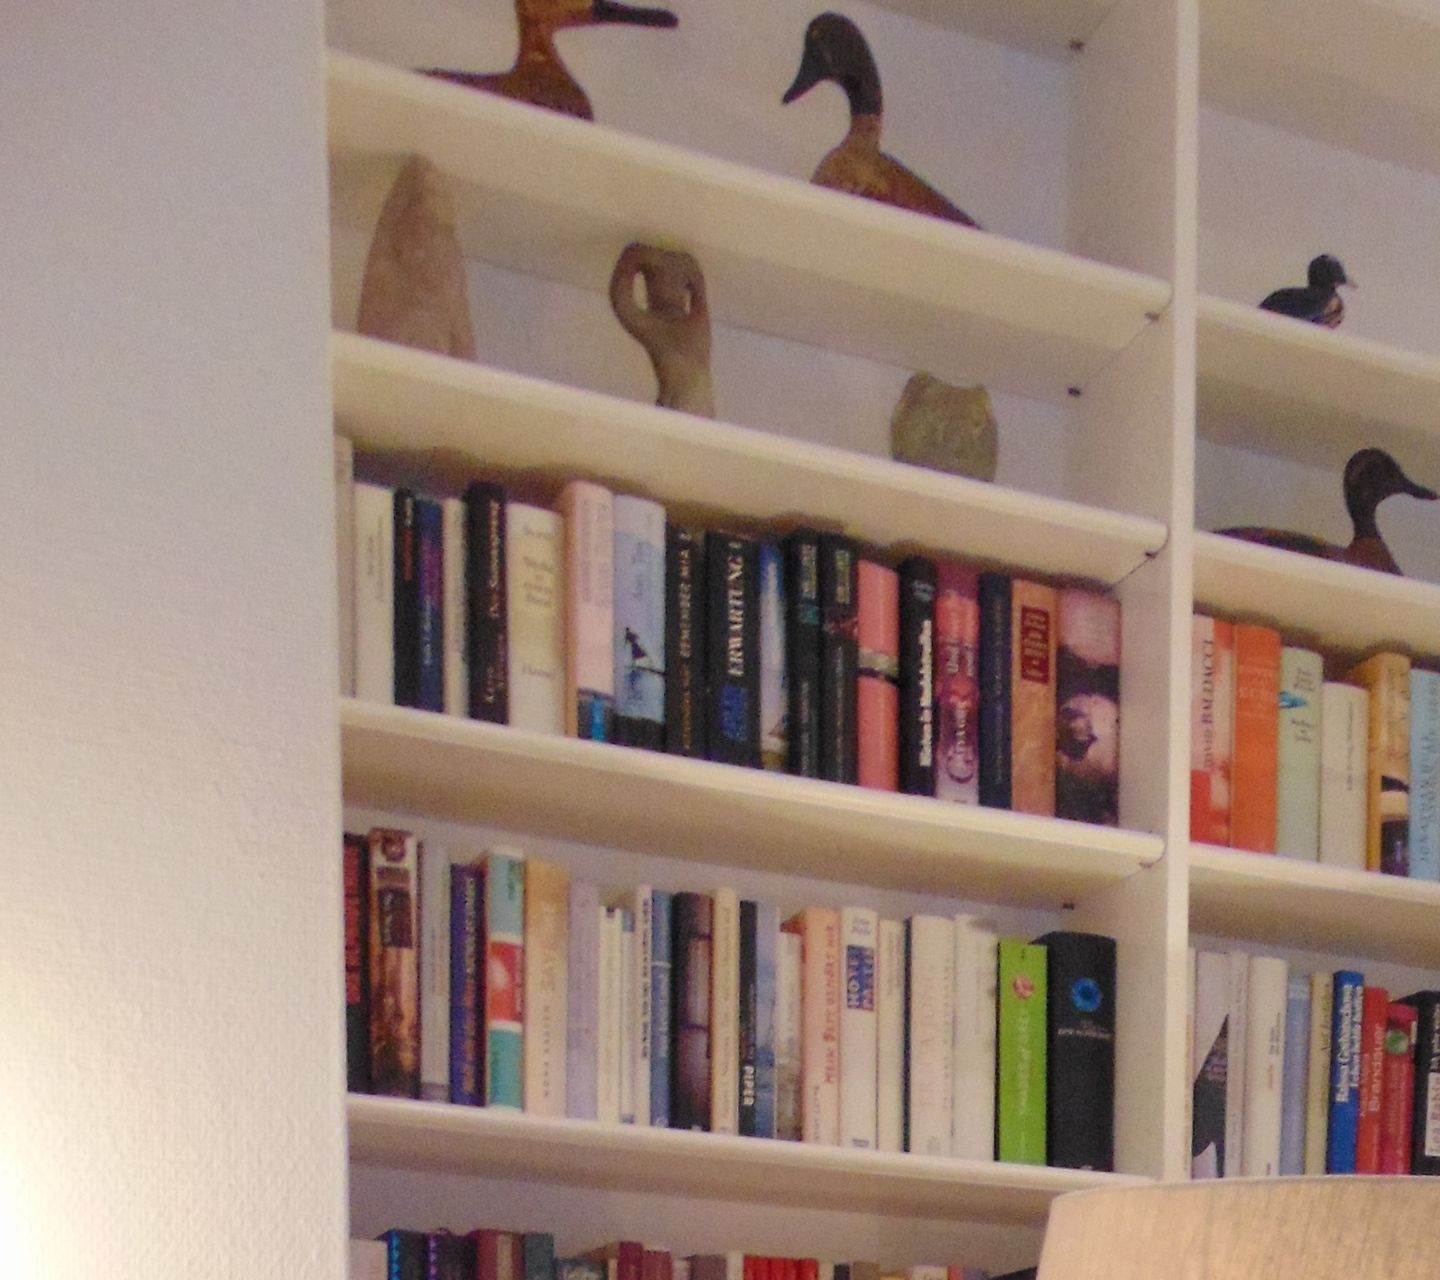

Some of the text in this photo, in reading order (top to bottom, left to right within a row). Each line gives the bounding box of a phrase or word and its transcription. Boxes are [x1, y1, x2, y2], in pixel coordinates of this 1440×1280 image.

[726, 556, 745, 678] ERWARTUNG
[1202, 639, 1215, 724] BALDACCI
[742, 1064, 755, 1107] PIPER
[1368, 1023, 1386, 1113] Brandauer
